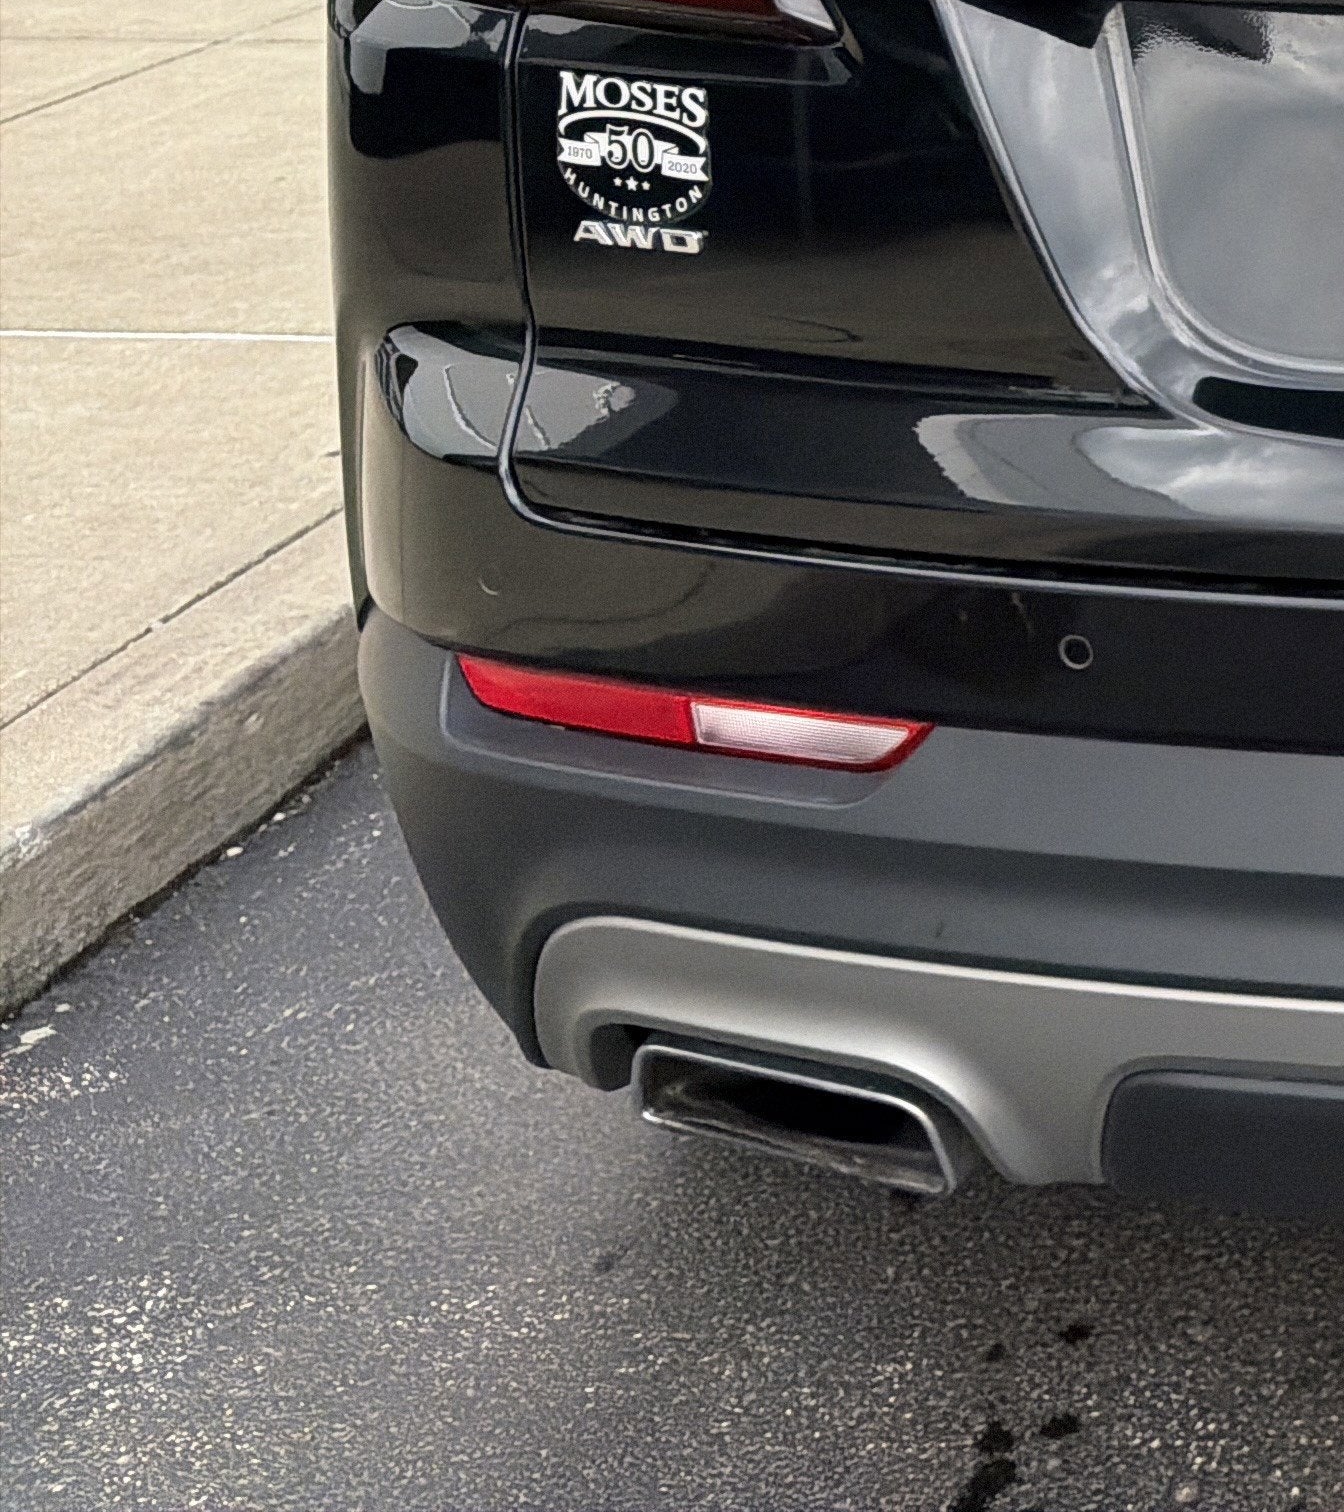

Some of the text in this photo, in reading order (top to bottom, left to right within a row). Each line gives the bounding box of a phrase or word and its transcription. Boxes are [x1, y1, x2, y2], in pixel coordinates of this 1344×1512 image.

[557, 70, 709, 129] MOSES
[566, 144, 594, 161] 1970
[605, 124, 656, 173] 50
[666, 159, 699, 176] 2020
[563, 167, 704, 223] HUNTINGTON
[573, 219, 709, 255] AWD
